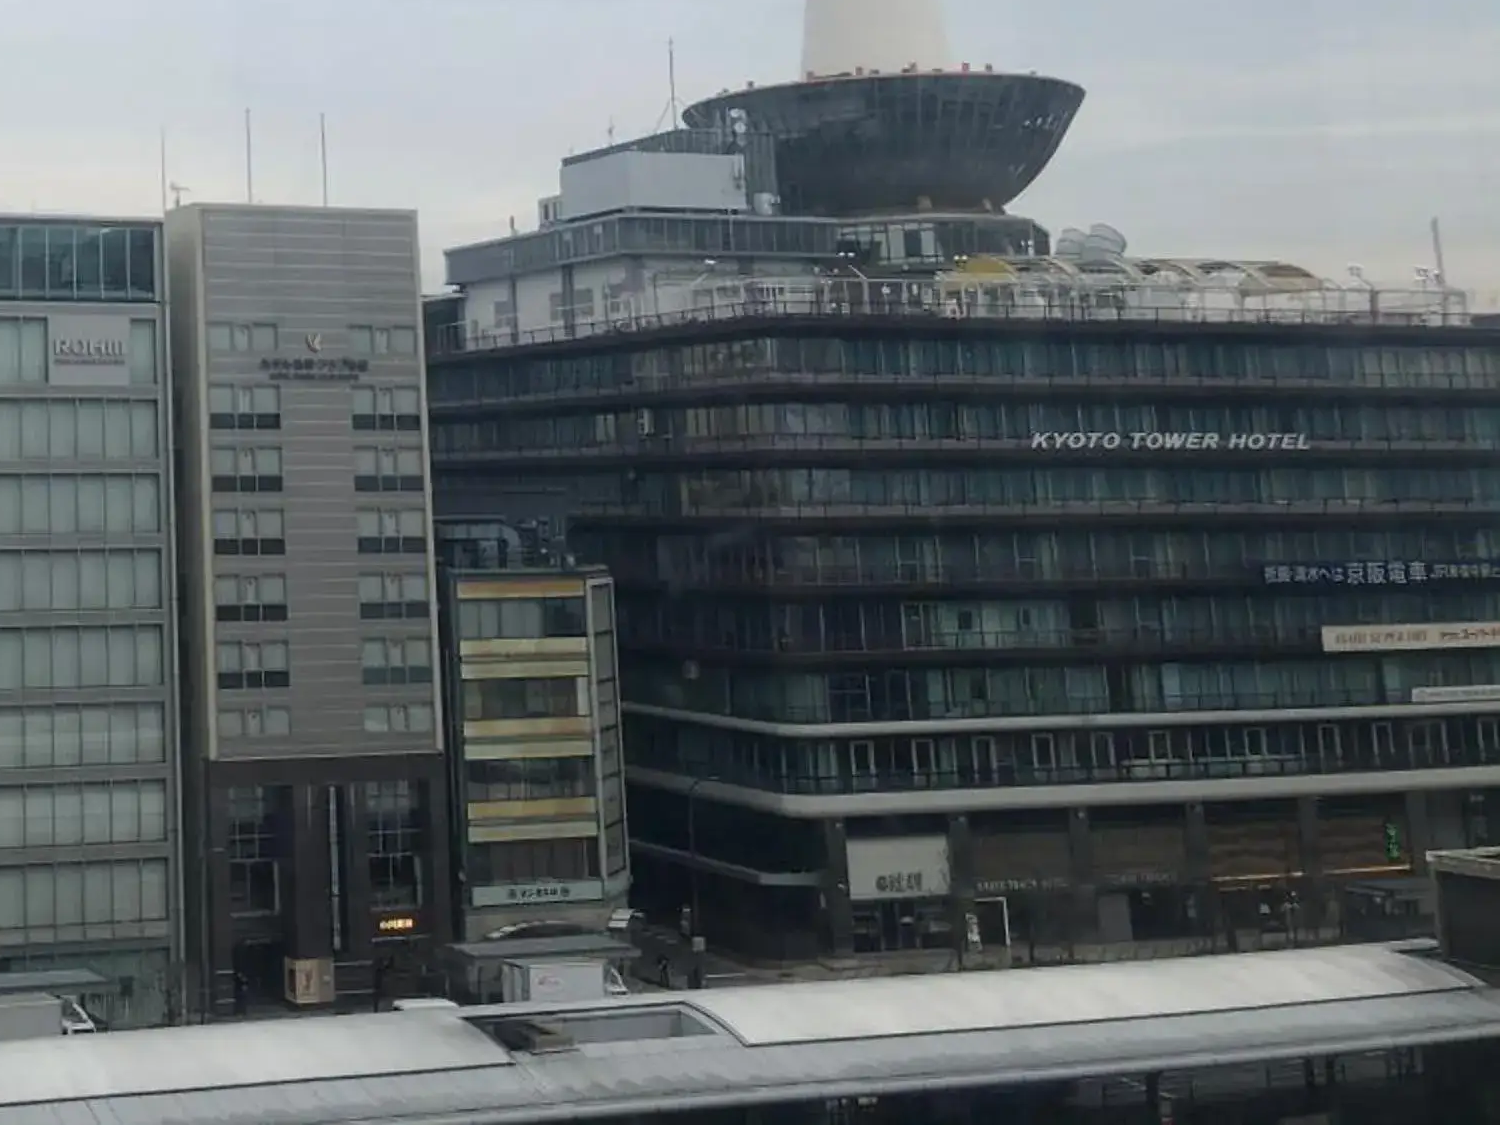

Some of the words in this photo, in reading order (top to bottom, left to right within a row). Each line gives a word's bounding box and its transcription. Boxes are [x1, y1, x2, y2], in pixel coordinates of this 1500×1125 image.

[1031, 432, 1121, 450] KYOTO
[1130, 432, 1220, 450] TOWER
[1228, 433, 1311, 450] HOTEL
[1347, 561, 1429, 585] 京阪電車
